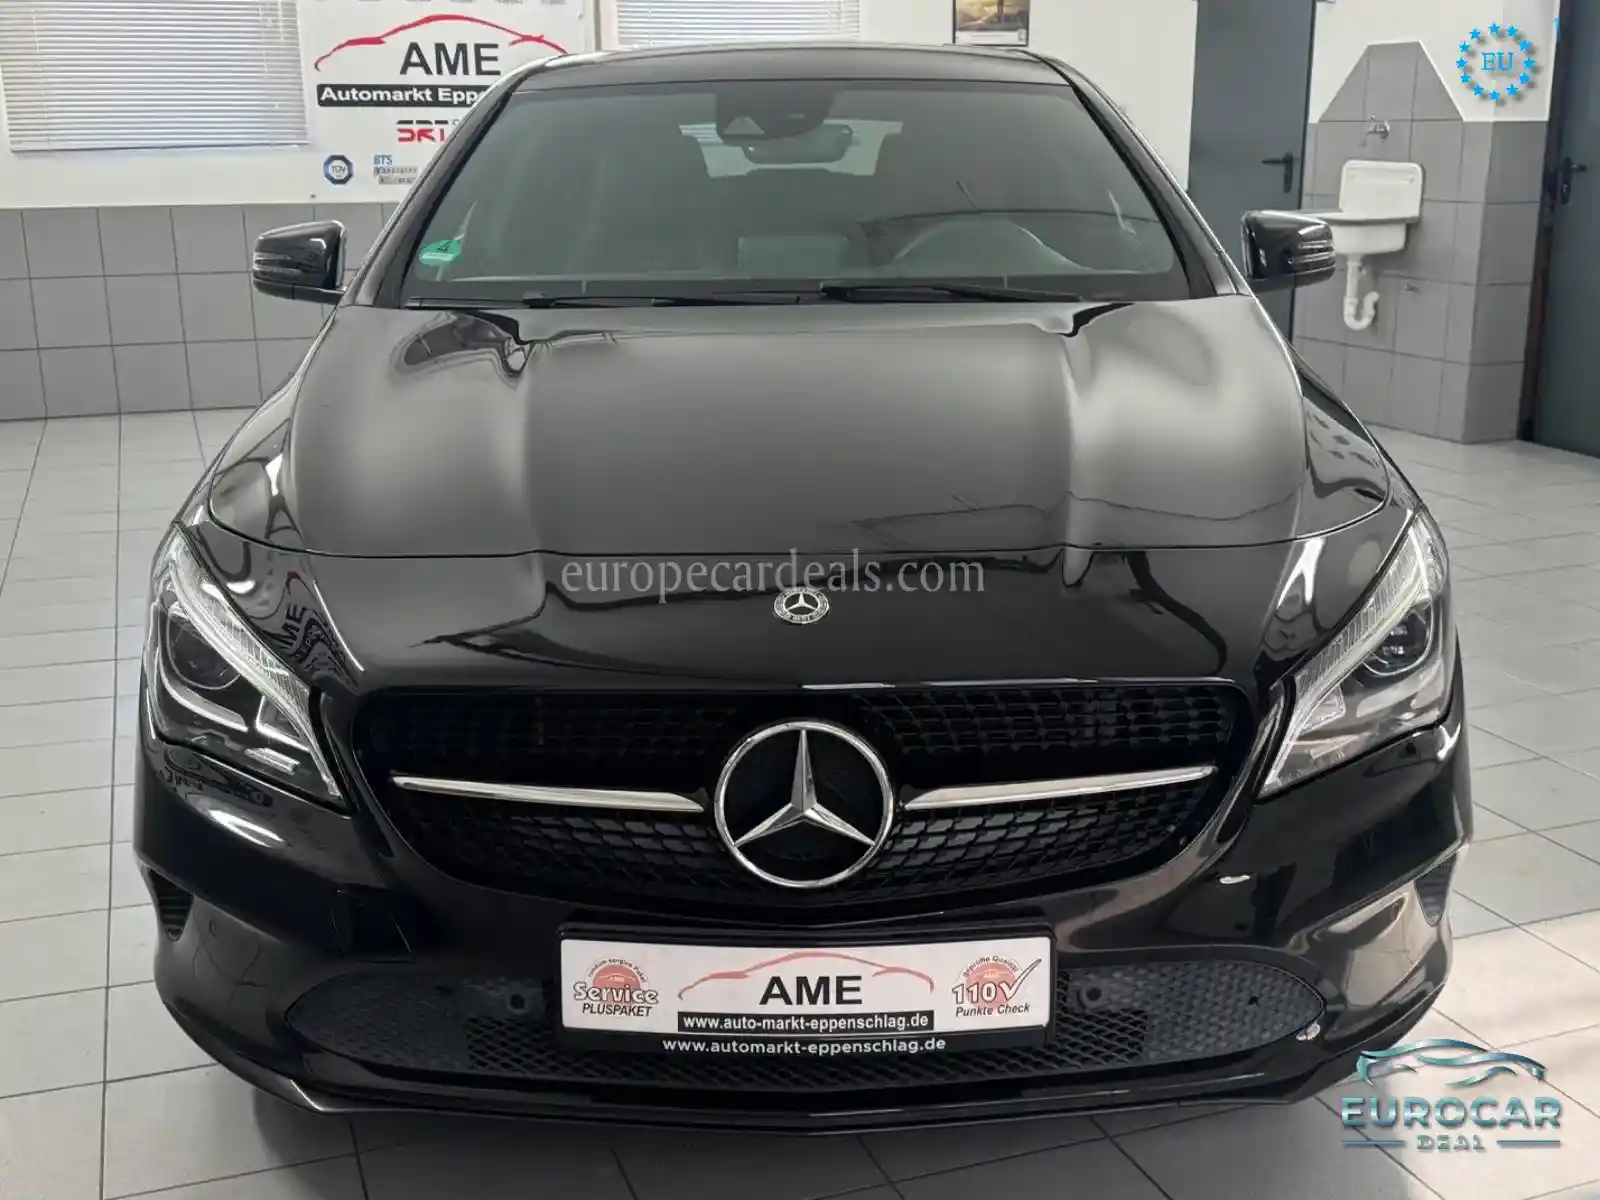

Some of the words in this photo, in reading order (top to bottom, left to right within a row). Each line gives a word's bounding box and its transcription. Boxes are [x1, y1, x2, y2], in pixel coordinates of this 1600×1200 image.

[400, 42, 501, 76] AME
[320, 86, 433, 101] Automarkt
[438, 87, 487, 105] Epp
[573, 980, 660, 1004] Service
[758, 974, 863, 1006] AME
[581, 1002, 653, 1017] PLUSPAKET
[955, 1005, 994, 1017] Punkte
[997, 1002, 1031, 1015] Check
[683, 1012, 929, 1033] www.auto-markt-eppenschlag.de
[662, 1037, 947, 1057] www.automarkt-eppenschlag.de
